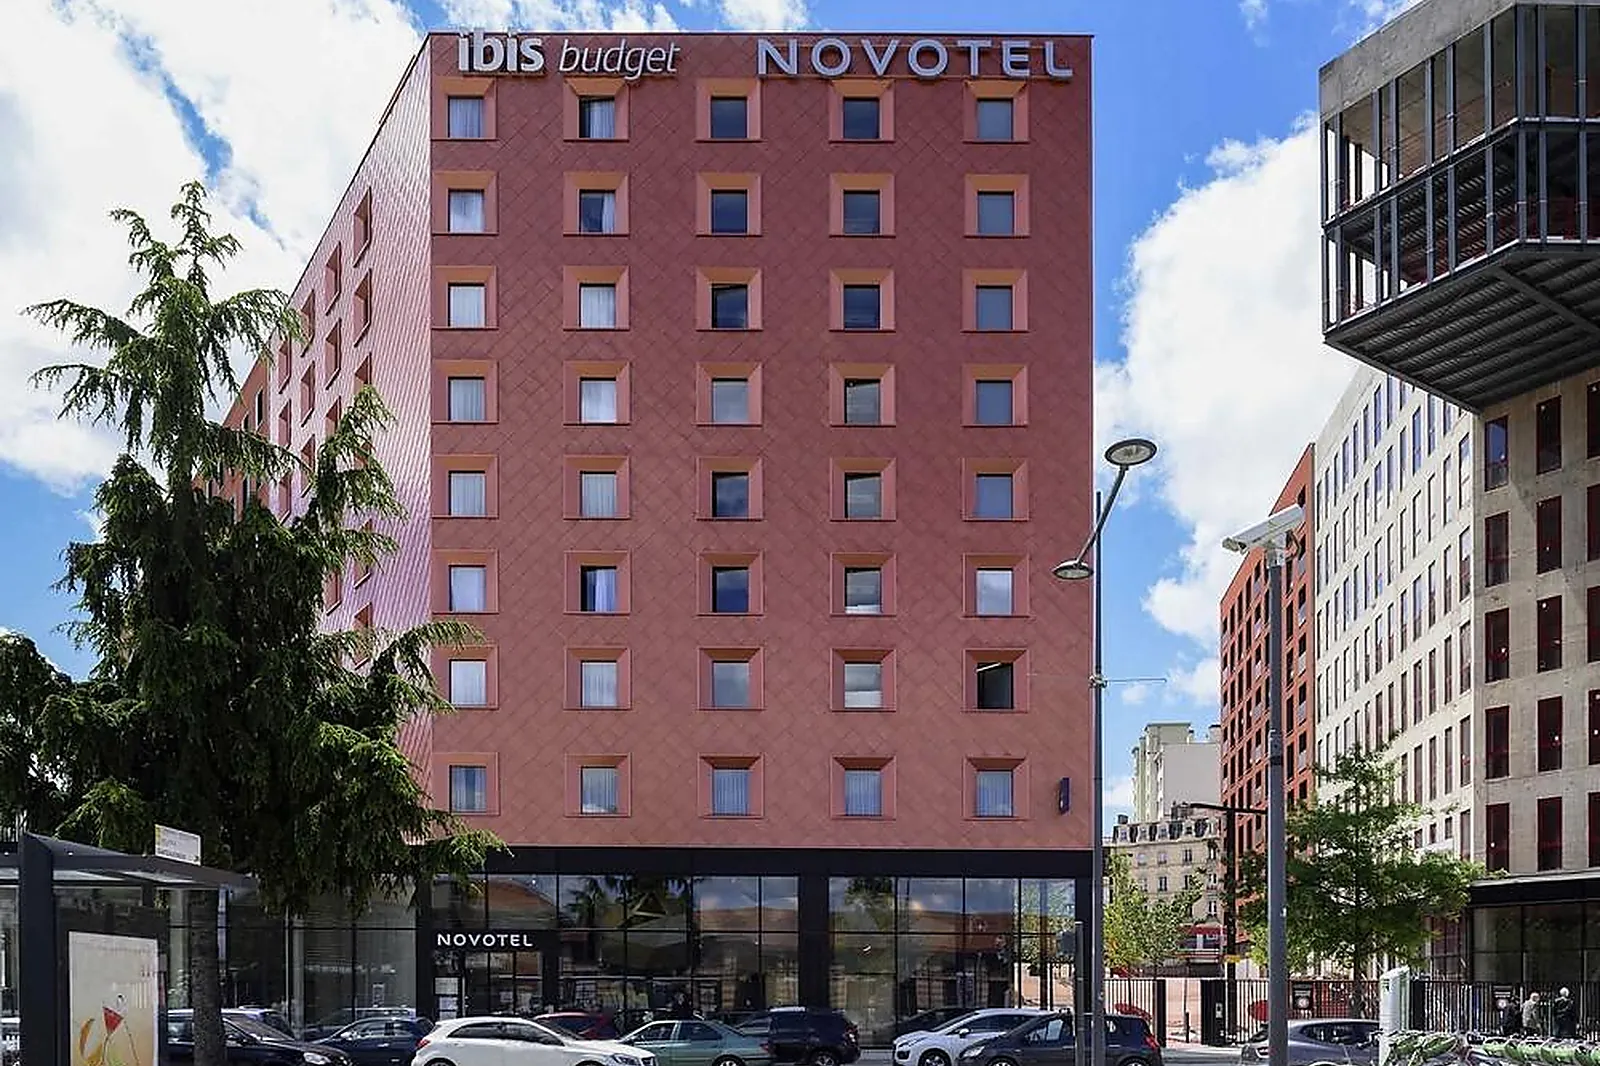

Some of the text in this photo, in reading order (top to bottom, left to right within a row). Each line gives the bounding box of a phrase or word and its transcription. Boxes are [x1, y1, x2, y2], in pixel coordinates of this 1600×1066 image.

[457, 29, 680, 80] ibis budget
[757, 38, 1074, 78] NOVOTEL
[436, 933, 533, 947] NOVOTEL
